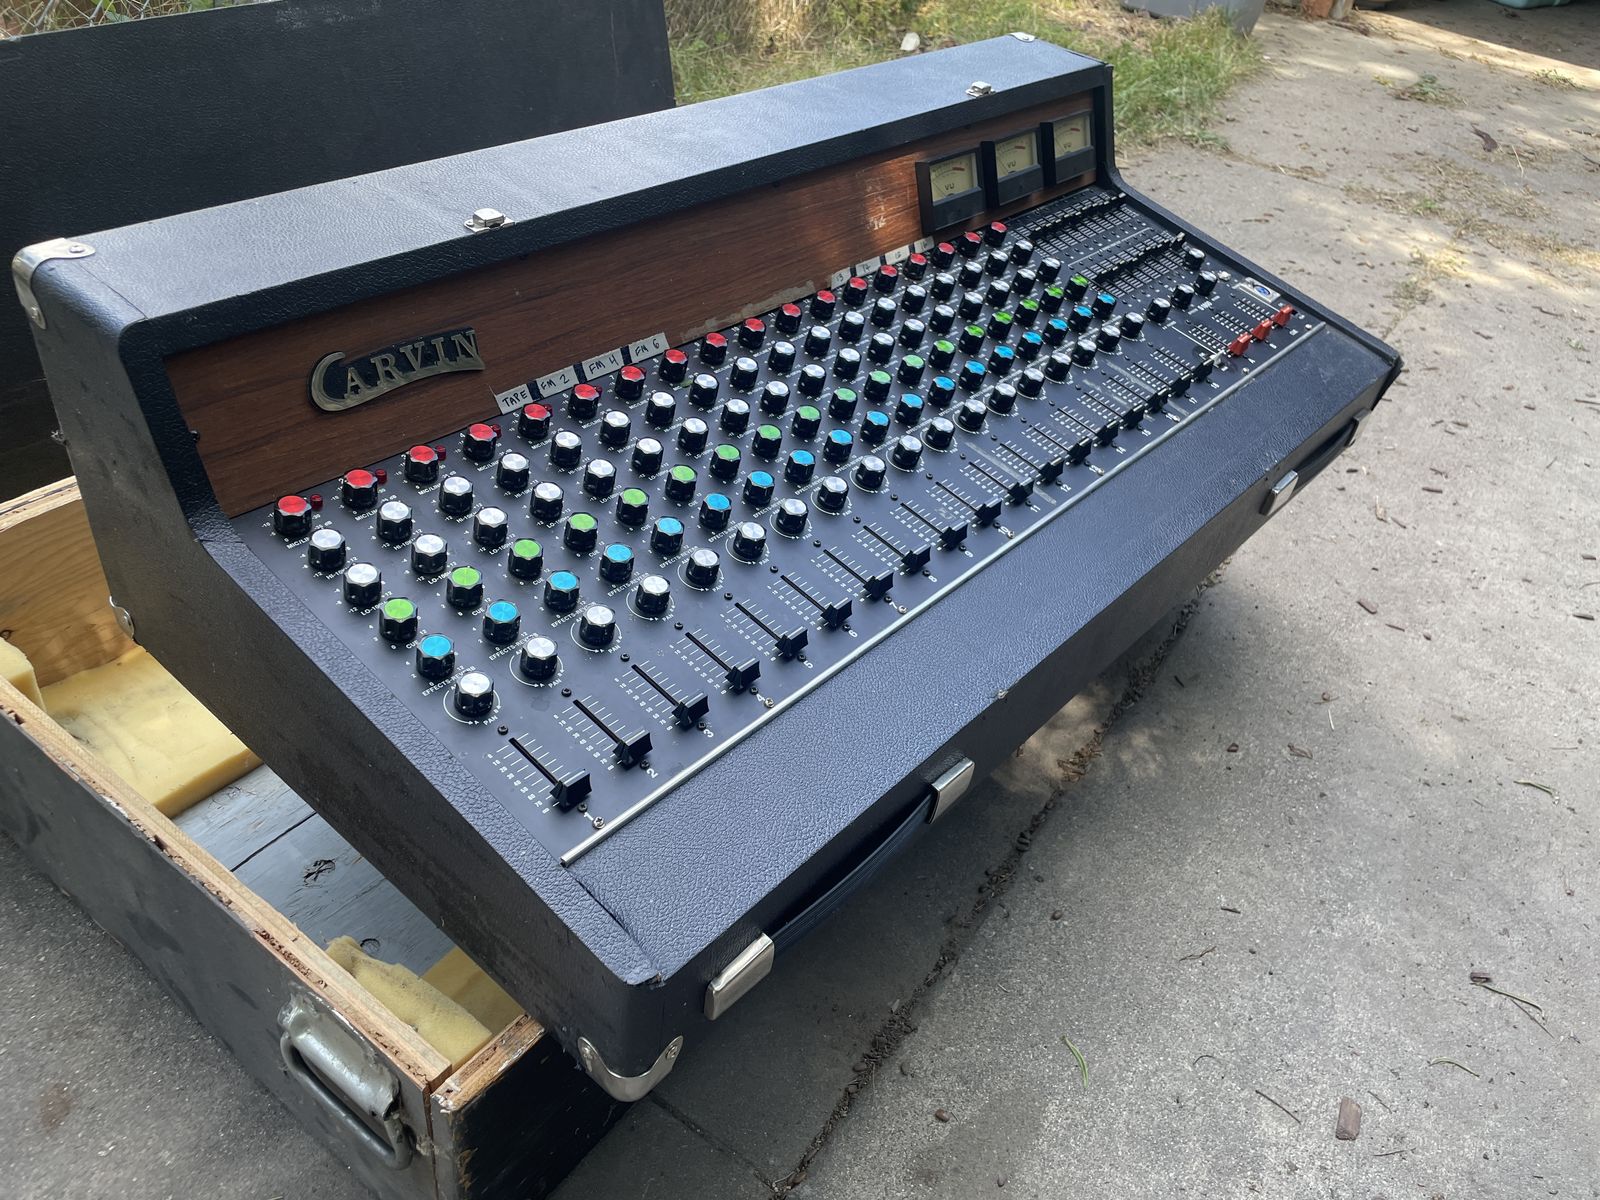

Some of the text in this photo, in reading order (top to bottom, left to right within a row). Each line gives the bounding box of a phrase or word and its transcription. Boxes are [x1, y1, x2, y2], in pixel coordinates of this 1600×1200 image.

[1007, 161, 1017, 169] VU
[944, 183, 955, 191] VU
[634, 339, 661, 356] FM 6
[589, 354, 620, 374] FM 4
[311, 330, 485, 412] CARVIN
[540, 374, 570, 391] FM 2
[501, 390, 528, 408] TAPE
[418, 483, 441, 495] MIC/LIN
[1060, 484, 1072, 492] 12
[1030, 504, 1041, 513] 11
[355, 509, 378, 521] MIC/LIN
[588, 550, 600, 558] CUE
[532, 577, 544, 586] CUE
[928, 575, 938, 583] 8
[472, 607, 485, 616] CUE
[662, 613, 674, 621] PAN
[848, 630, 858, 638] 6
[607, 645, 621, 653] PAN
[803, 660, 814, 669] 5
[548, 679, 562, 688] PAN
[756, 693, 765, 702] 4
[483, 715, 498, 726] PAN
[703, 729, 714, 738] 3
[646, 768, 659, 779] 2
[583, 812, 594, 820] 1
